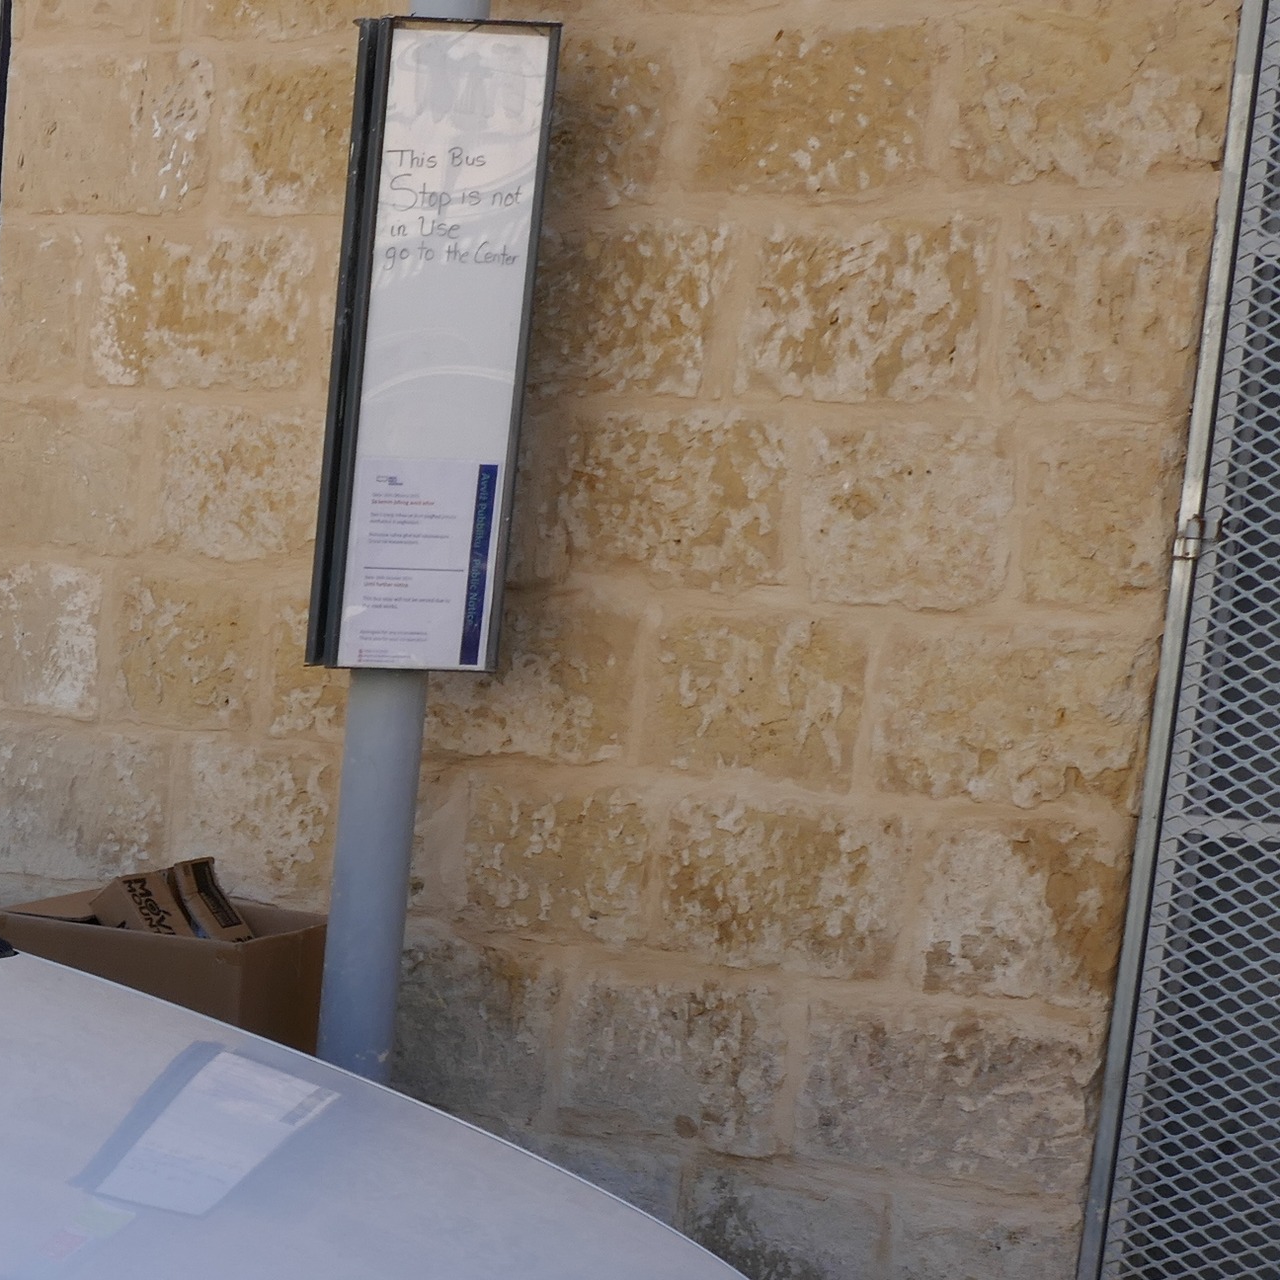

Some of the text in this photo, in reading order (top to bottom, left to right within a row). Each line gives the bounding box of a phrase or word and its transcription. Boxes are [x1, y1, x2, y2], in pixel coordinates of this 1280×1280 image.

[386, 146, 487, 168] This Bus
[390, 173, 522, 215] Stop is not
[390, 215, 461, 239] in Use
[383, 241, 520, 271] go to the Center
[469, 559, 481, 590] Public
